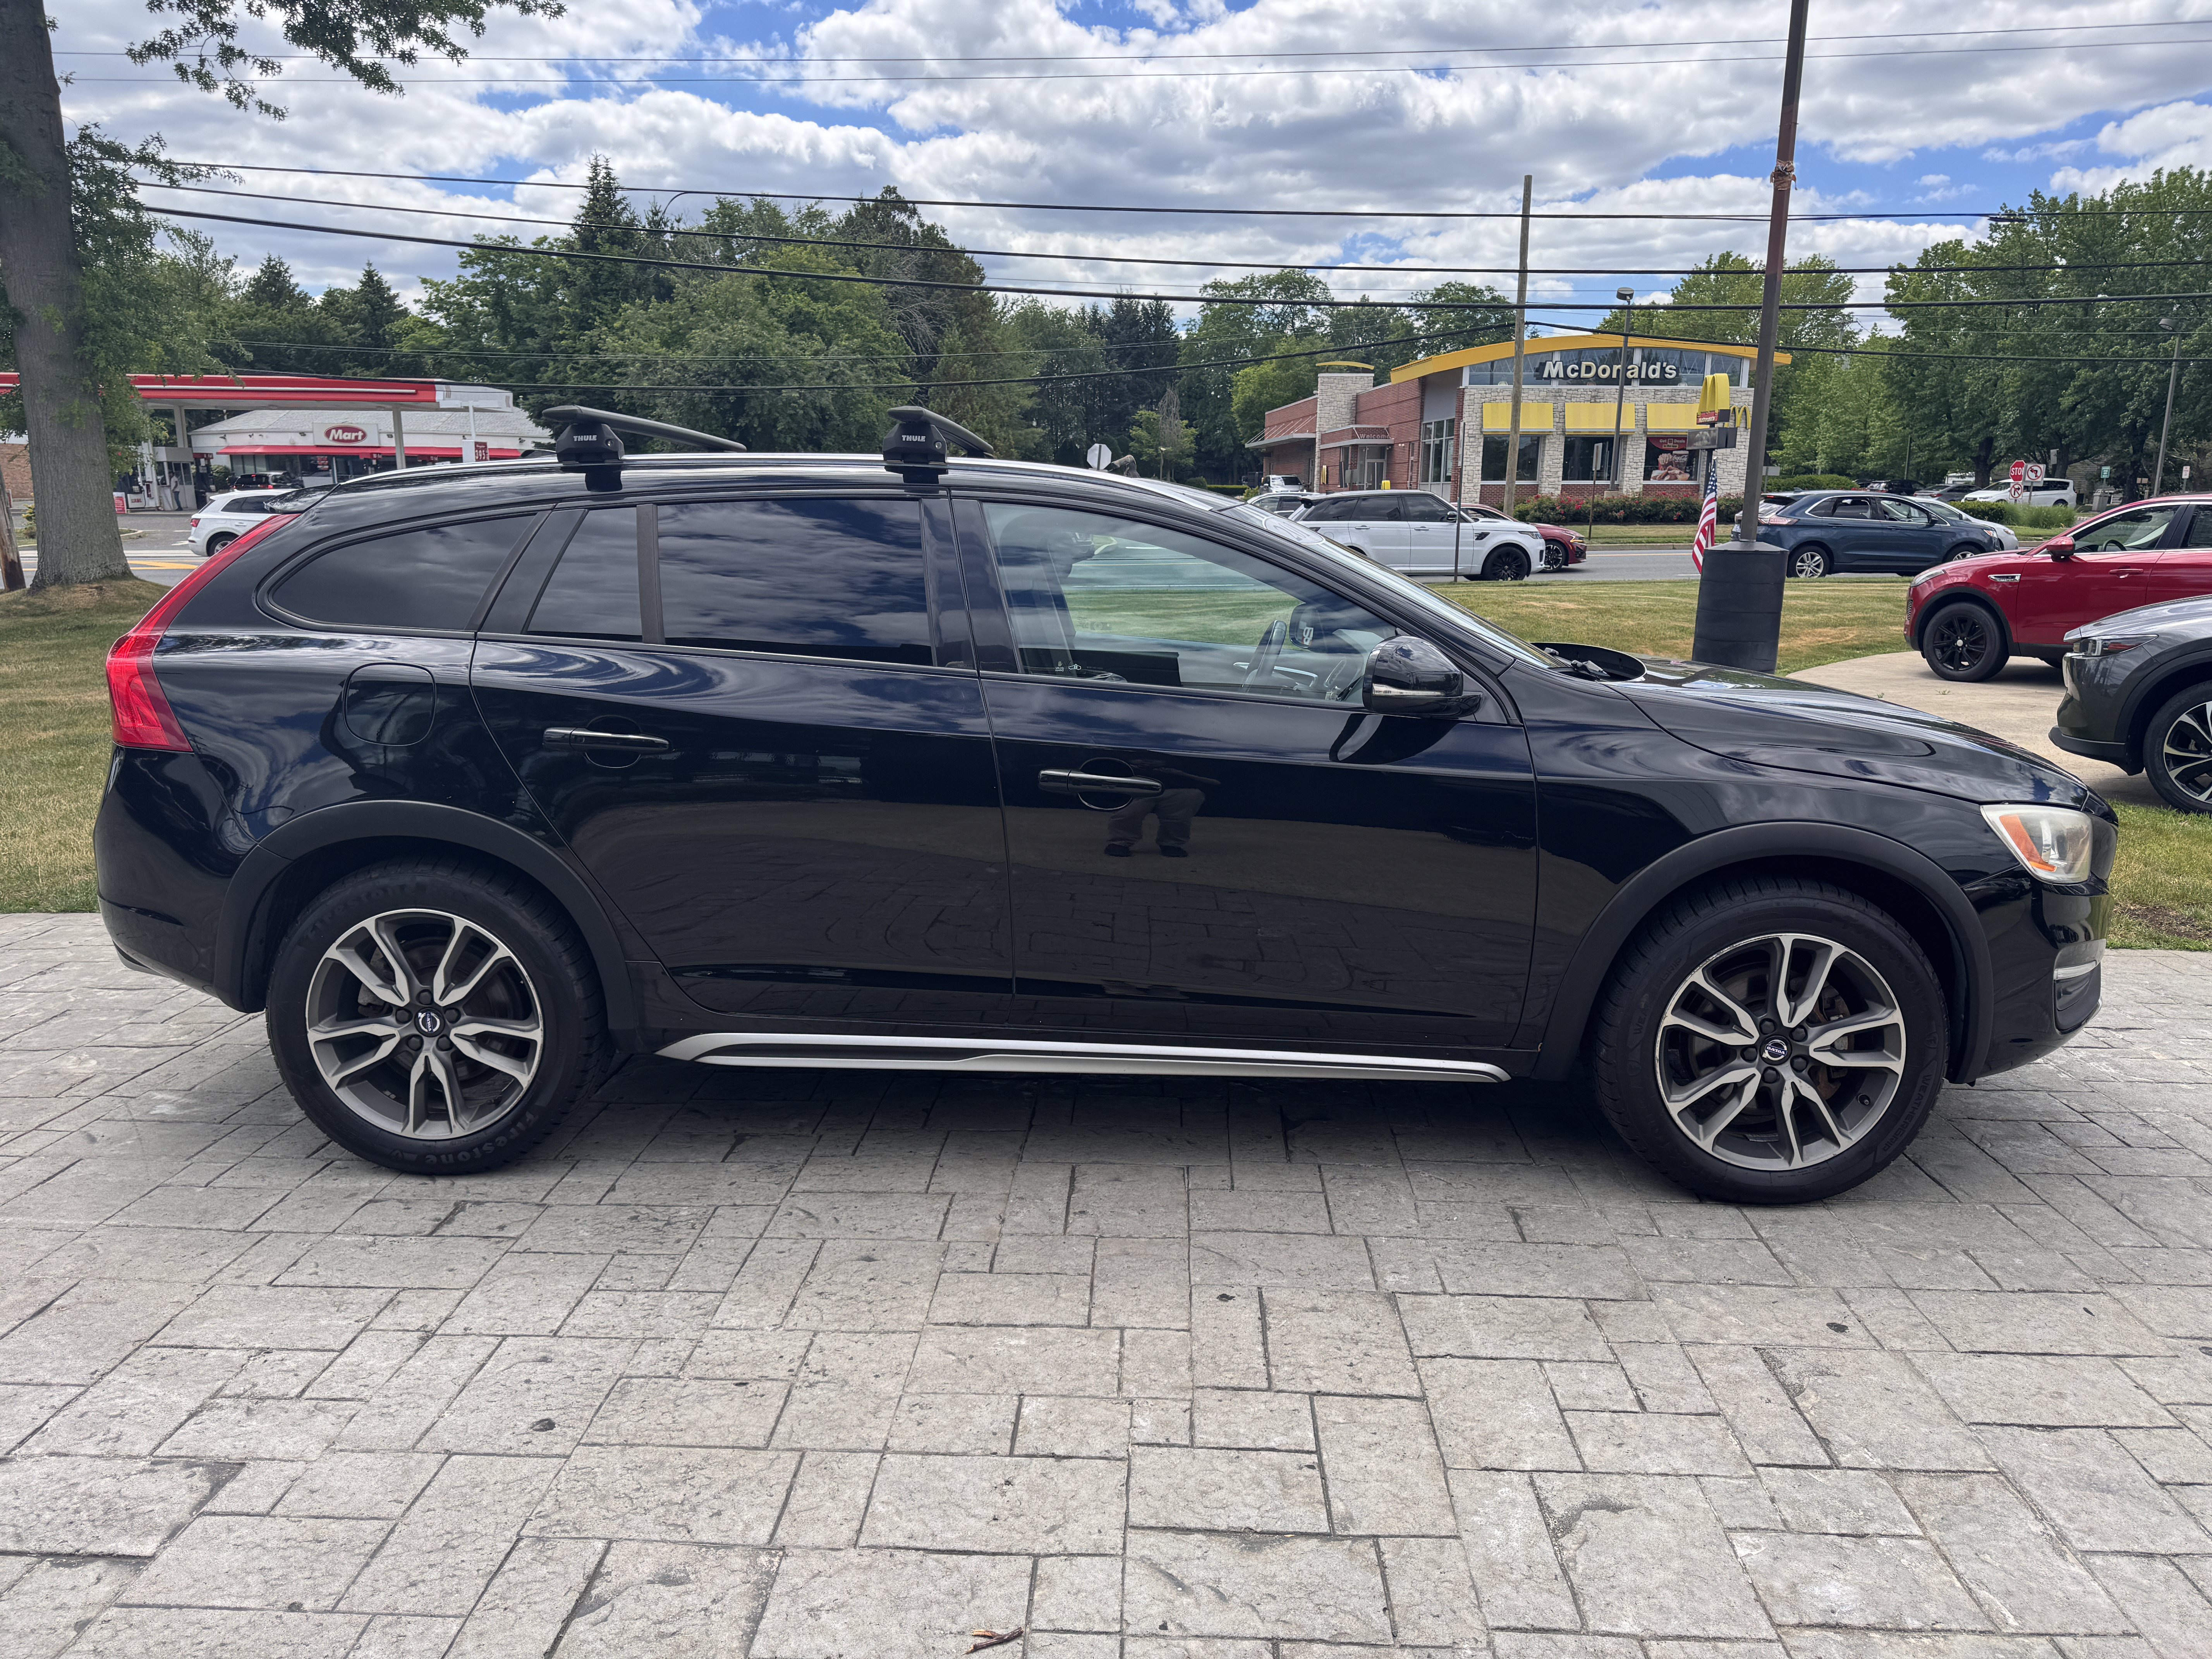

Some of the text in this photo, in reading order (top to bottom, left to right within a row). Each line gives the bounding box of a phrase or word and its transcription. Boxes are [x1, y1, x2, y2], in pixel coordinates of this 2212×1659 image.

[1542, 361, 1677, 379] McDonald's
[328, 429, 364, 441] Mart
[1766, 1046, 1785, 1055] VOLVO
[425, 1110, 539, 1164] Firestone
